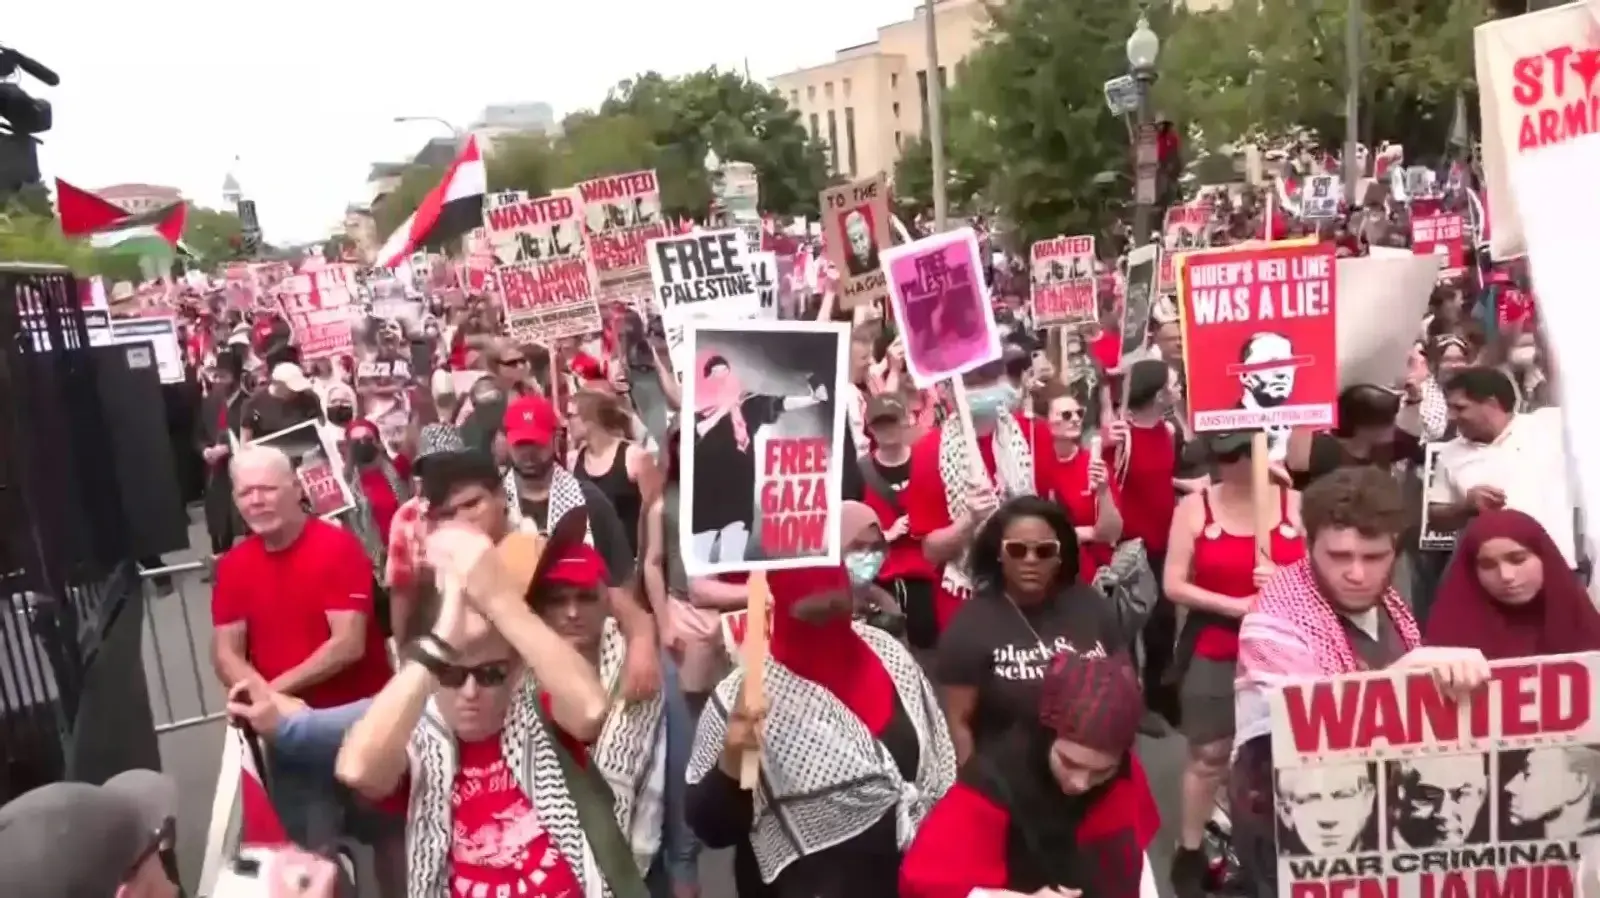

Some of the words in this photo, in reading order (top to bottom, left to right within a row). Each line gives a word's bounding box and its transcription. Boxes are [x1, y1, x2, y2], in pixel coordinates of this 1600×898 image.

[580, 173, 656, 202] WANTED
[827, 193, 846, 208] TO
[853, 182, 877, 201] THE
[488, 197, 574, 231] WANTED
[656, 233, 744, 283] FREE
[1034, 238, 1091, 260] WANTED
[1190, 260, 1254, 288] BIDEN'S
[1257, 257, 1287, 282] RED
[1291, 254, 1331, 280] LINE
[660, 273, 756, 308] PALESTINE
[1191, 285, 1250, 326] WAS
[1258, 285, 1275, 321] A
[1281, 279, 1330, 318] LIE!
[764, 438, 828, 476] FREE
[760, 478, 828, 514] GAZA
[761, 515, 827, 555] NOW
[1283, 661, 1591, 753] WANTED
[1289, 855, 1384, 880] WAR
[1391, 841, 1582, 874] CRIMINAL
